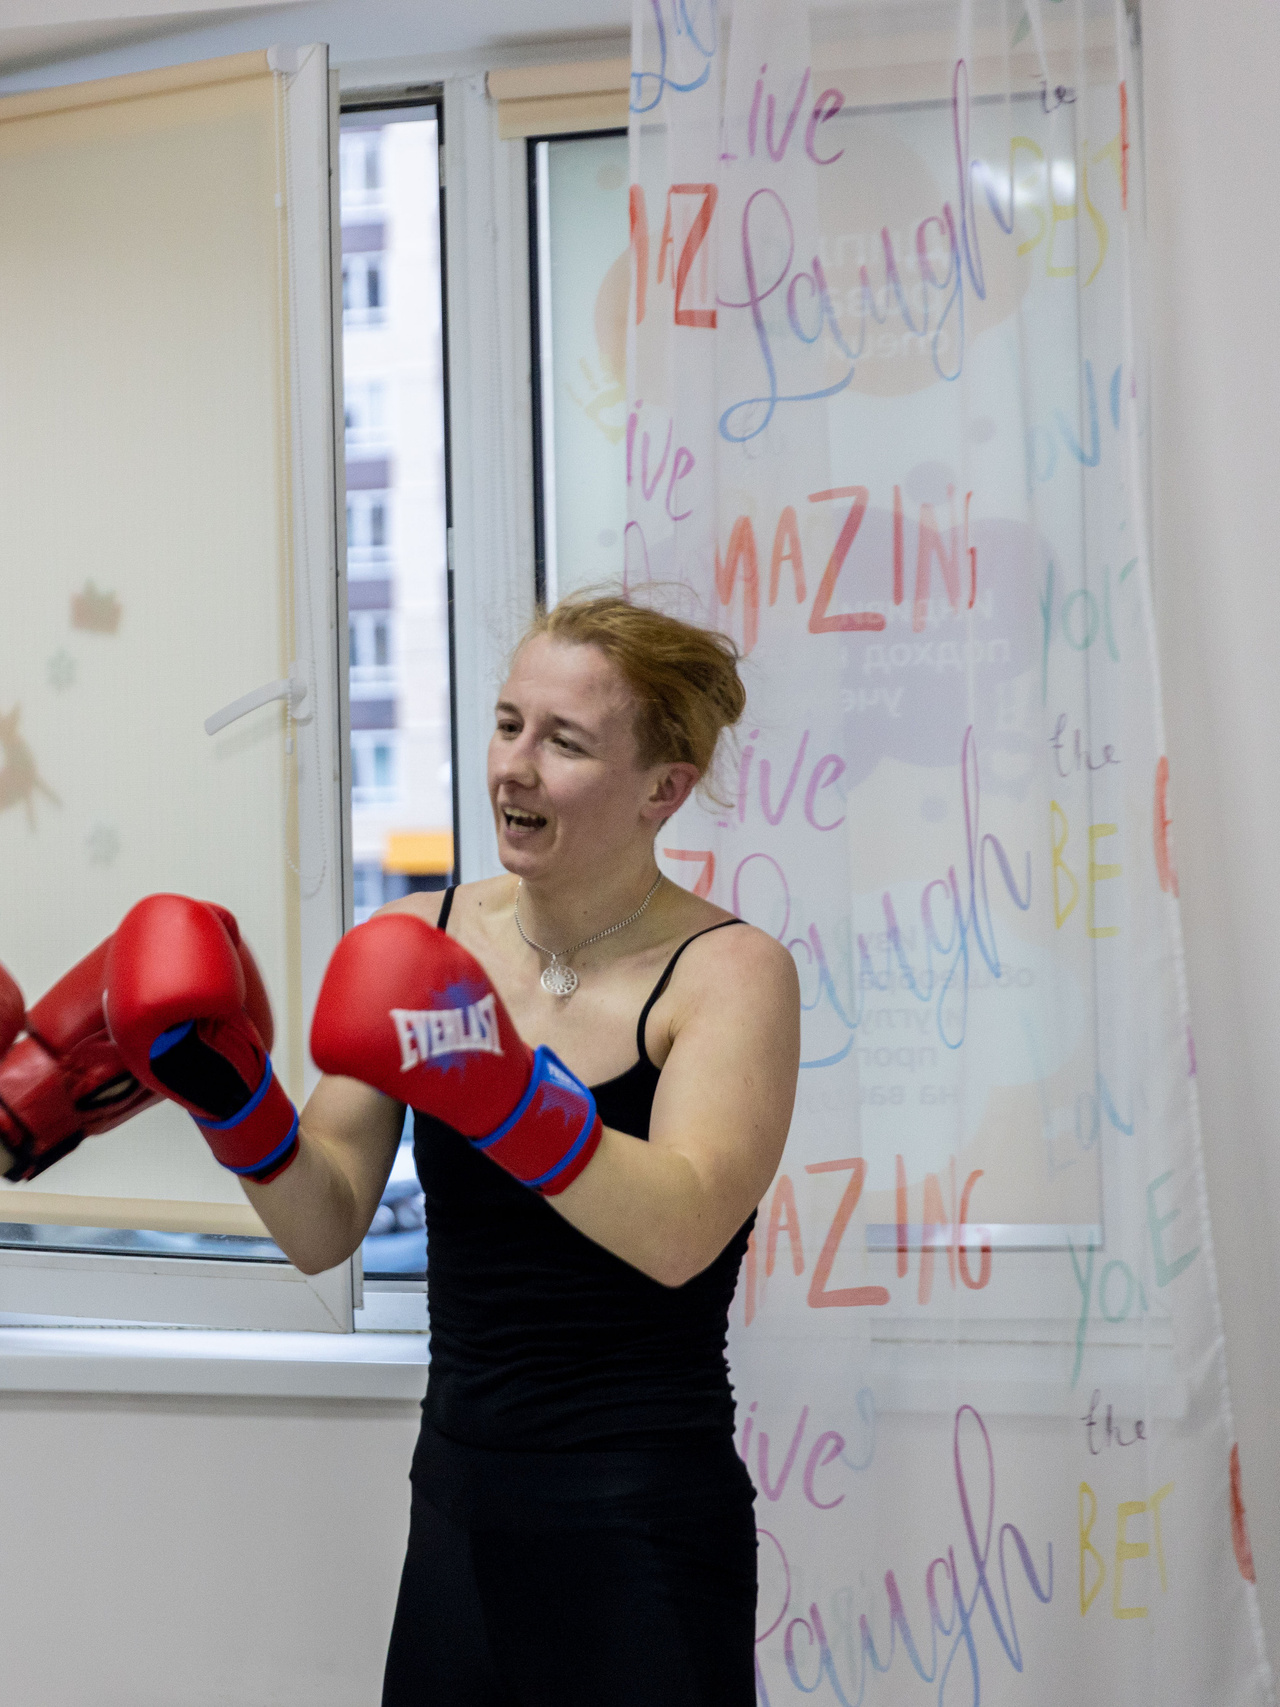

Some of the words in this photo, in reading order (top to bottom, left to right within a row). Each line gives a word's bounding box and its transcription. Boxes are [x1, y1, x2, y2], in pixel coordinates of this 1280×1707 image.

[720, 64, 845, 165] ive
[716, 58, 1014, 443] Laugh
[715, 729, 846, 831] ive
[1081, 1389, 1147, 1456] the
